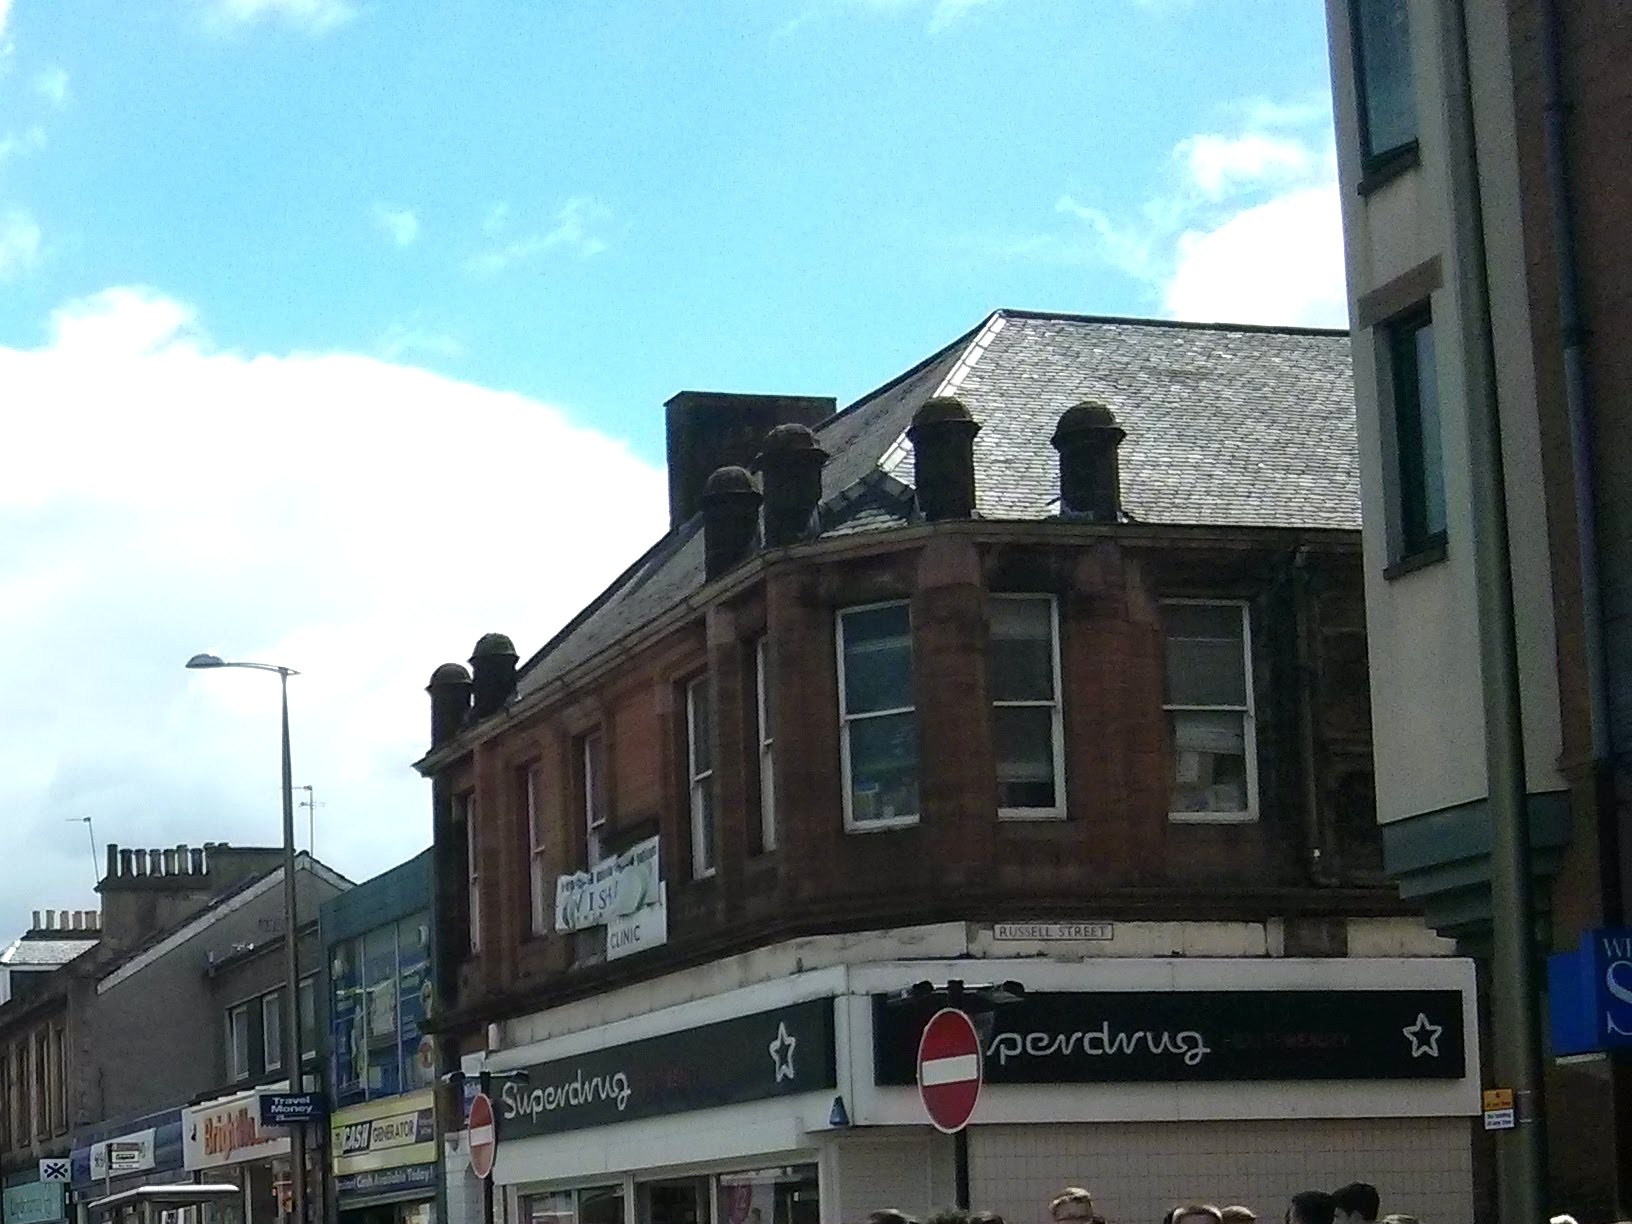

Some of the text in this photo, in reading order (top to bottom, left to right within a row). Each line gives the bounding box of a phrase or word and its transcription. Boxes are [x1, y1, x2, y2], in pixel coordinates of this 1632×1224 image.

[609, 925, 641, 949] CLINIC
[999, 925, 1106, 938] RUSSELL STREET
[987, 1021, 1210, 1065] perdrug
[272, 1096, 311, 1105] Travel
[502, 1069, 631, 1123] Superdrug
[270, 1105, 314, 1115] Money
[342, 1124, 369, 1150] CASH
[373, 1120, 414, 1142] GENERATOR
